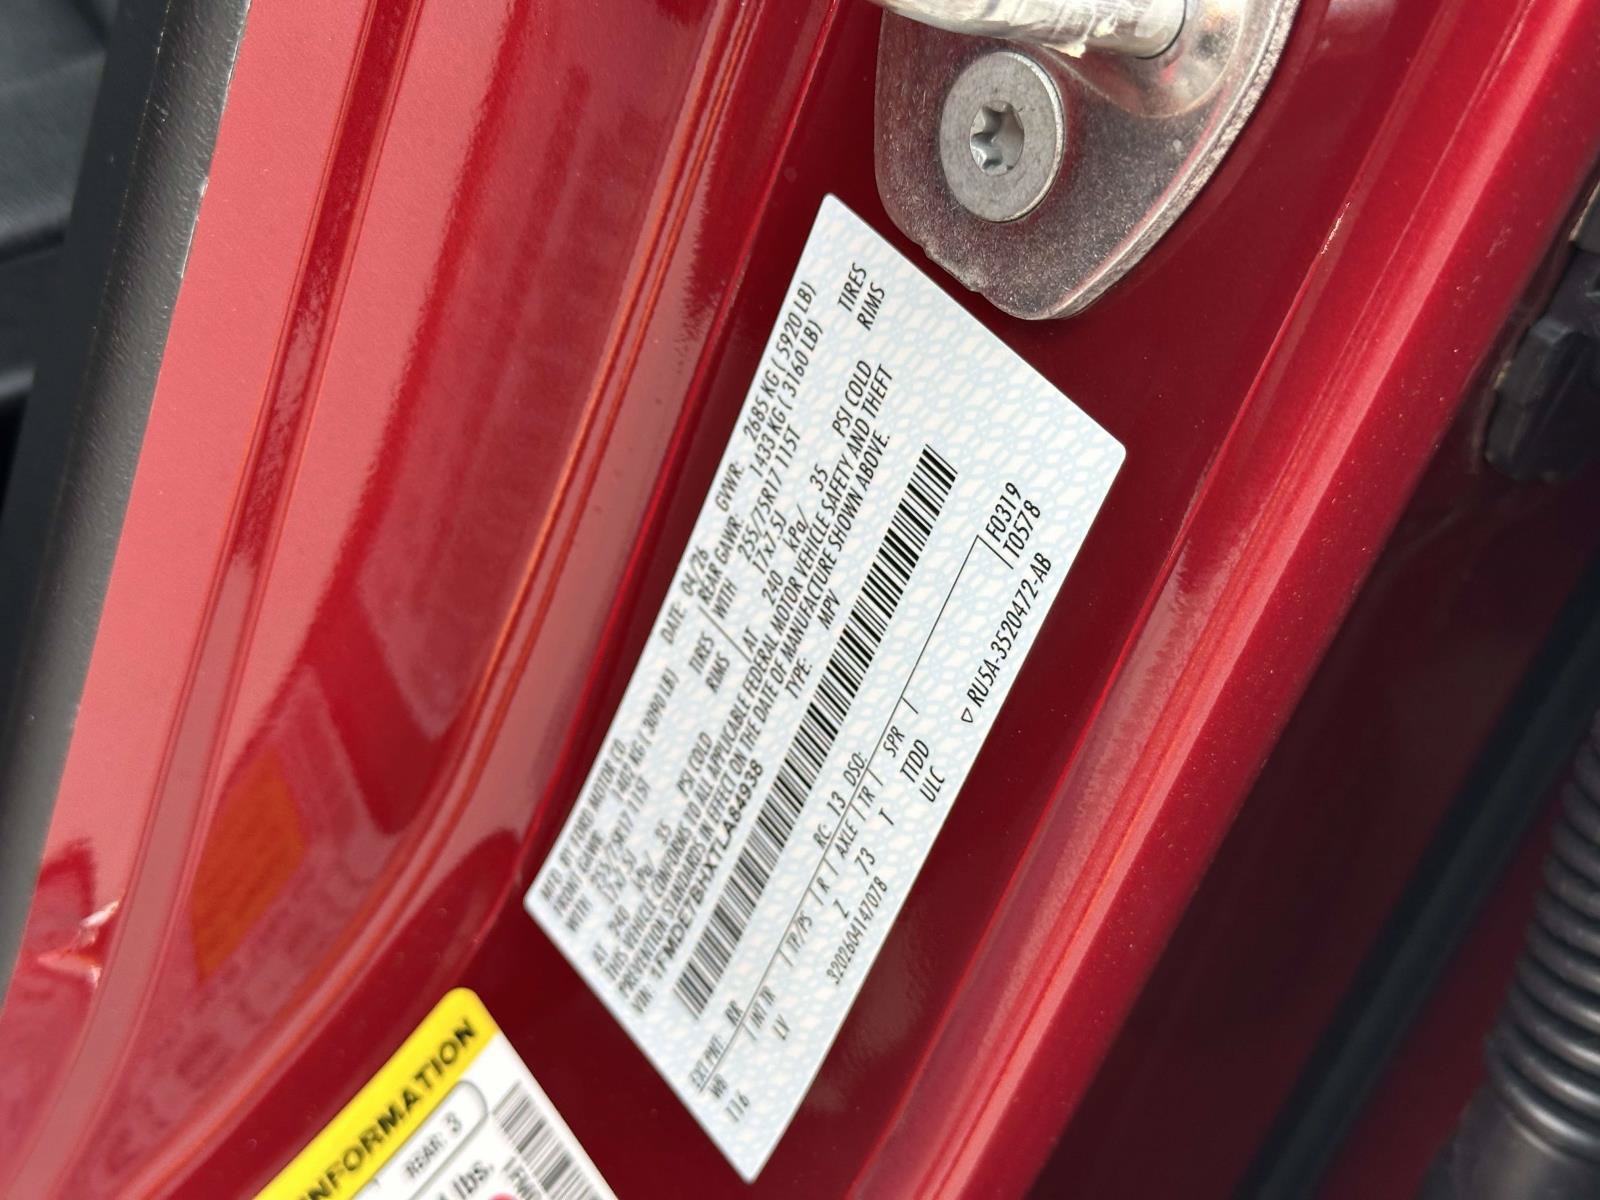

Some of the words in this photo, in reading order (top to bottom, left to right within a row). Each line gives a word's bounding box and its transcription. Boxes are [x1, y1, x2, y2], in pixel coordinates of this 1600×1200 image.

[837, 262, 866, 312] TIRES
[856, 281, 884, 331] RIMS
[714, 462, 742, 512] GVWR:
[742, 395, 769, 442] 2685
[760, 369, 779, 398] KG
[775, 311, 802, 360] 5920
[793, 280, 816, 313] LB)
[697, 562, 722, 604] REAR
[714, 515, 742, 565] GAWR:
[748, 432, 775, 477] 1433
[766, 406, 785, 435] KG
[781, 349, 809, 398] 3160
[799, 319, 822, 351] LB)
[855, 429, 890, 491] ABOVE.
[712, 577, 737, 619] WITH
[737, 466, 782, 562] 255/75R17
[774, 423, 800, 468] 115T
[742, 626, 758, 653] AT
[761, 569, 783, 606] 240
[809, 463, 828, 492] 35
[831, 405, 853, 437] PSI
[844, 359, 871, 406] COLD
[827, 486, 863, 552] SHOWN
[985, 481, 1021, 542] F0319
[1002, 499, 1040, 558] T0578
[680, 545, 712, 596] 04/26
[751, 509, 787, 574] 17x7.5J
[775, 547, 837, 663] MANUFACTURE
[966, 552, 1051, 708] RU5A-3520472-AB
[603, 949, 627, 980] THIS
[621, 895, 656, 949] VEHICLE
[651, 823, 691, 897] CONFORMS
[683, 801, 700, 825] TO
[694, 777, 713, 806] ALL
[706, 693, 750, 779] APPLICABLE
[742, 633, 779, 698] FEDERAL
[769, 575, 803, 635] MOTOR
[793, 511, 830, 577] VEHICLE
[821, 453, 853, 516] SAFETY
[846, 417, 869, 459] AND
[860, 363, 892, 418] THEFT
[688, 631, 714, 674] TIRES
[705, 652, 729, 693] RIMS
[769, 657, 787, 684] OF
[784, 658, 812, 699] TYPE:
[816, 588, 840, 630] MPV
[752, 680, 778, 723] DATE
[676, 769, 695, 796] PSI
[687, 731, 712, 772] COLD
[728, 748, 747, 775] ON
[739, 718, 760, 751] THE
[552, 871, 580, 916] FRONT
[628, 743, 643, 765] KG
[659, 667, 678, 696] LB)
[706, 771, 736, 824] EFFECT
[842, 751, 867, 787] DSO:
[919, 765, 945, 802] ULC
[569, 808, 593, 847] FORD
[588, 760, 615, 810] MOTOR
[698, 823, 714, 841] IN
[826, 790, 846, 817] 13
[661, 839, 706, 918] STANDARDS
[750, 1001, 766, 1028] INT
[758, 986, 774, 1005] TR
[785, 910, 812, 953] TP/PS
[816, 877, 829, 892] R
[834, 818, 858, 859] AXLE
[857, 785, 875, 808] TR
[882, 725, 905, 758] SPR
[772, 1014, 790, 1041] LV
[832, 899, 849, 919] Z
[854, 846, 875, 876] 73
[878, 807, 894, 825] T
[899, 738, 929, 783] TTDD
[618, 907, 668, 998] PREVENTION
[826, 875, 887, 985] 3202604147078
[725, 1001, 742, 1026] RR
[296, 1018, 477, 1200] NFORMATION
[444, 1111, 463, 1135] 3
